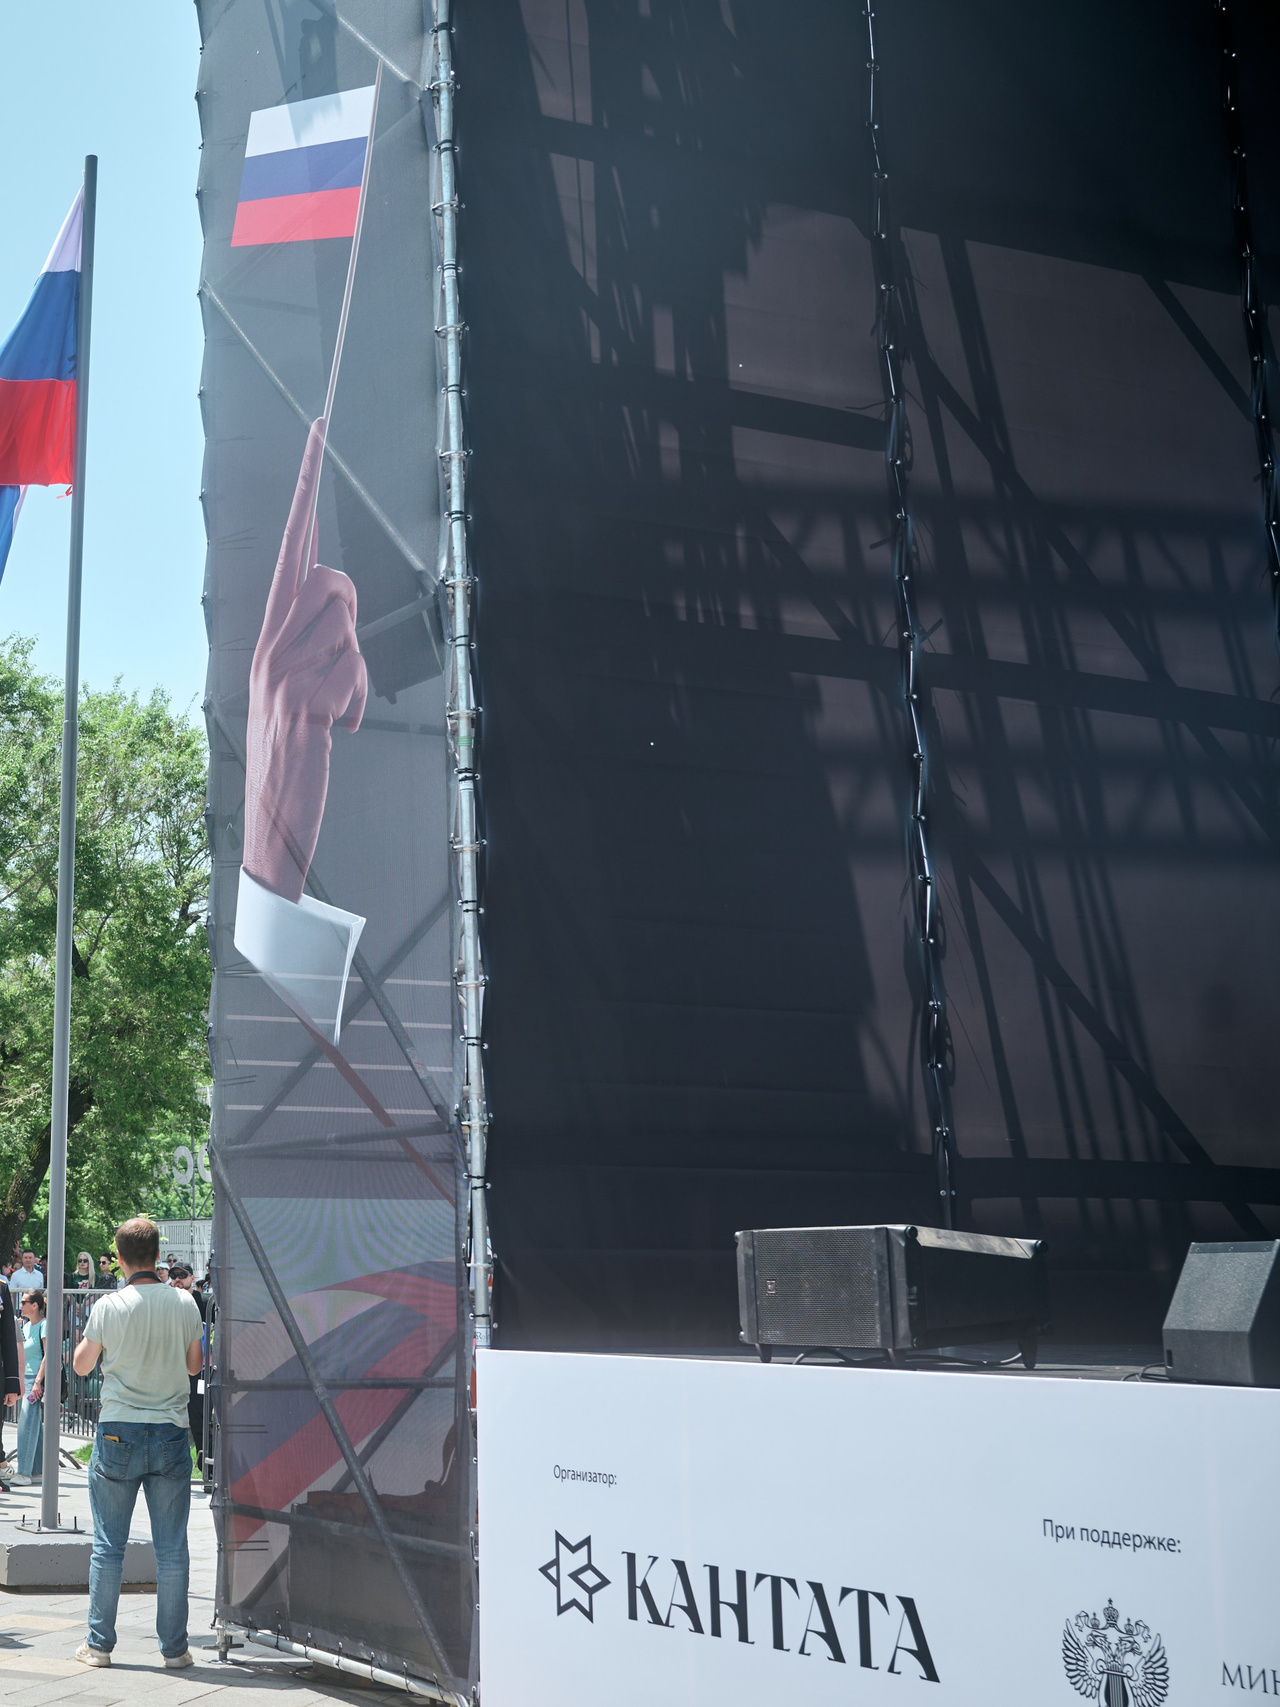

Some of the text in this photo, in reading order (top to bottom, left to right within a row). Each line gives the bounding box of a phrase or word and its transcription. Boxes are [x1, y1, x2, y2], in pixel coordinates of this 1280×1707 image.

[553, 1464, 617, 1488] Организатор:
[1043, 1518, 1182, 1554] При поддержке:
[621, 1551, 941, 1683] КАНТАТА
